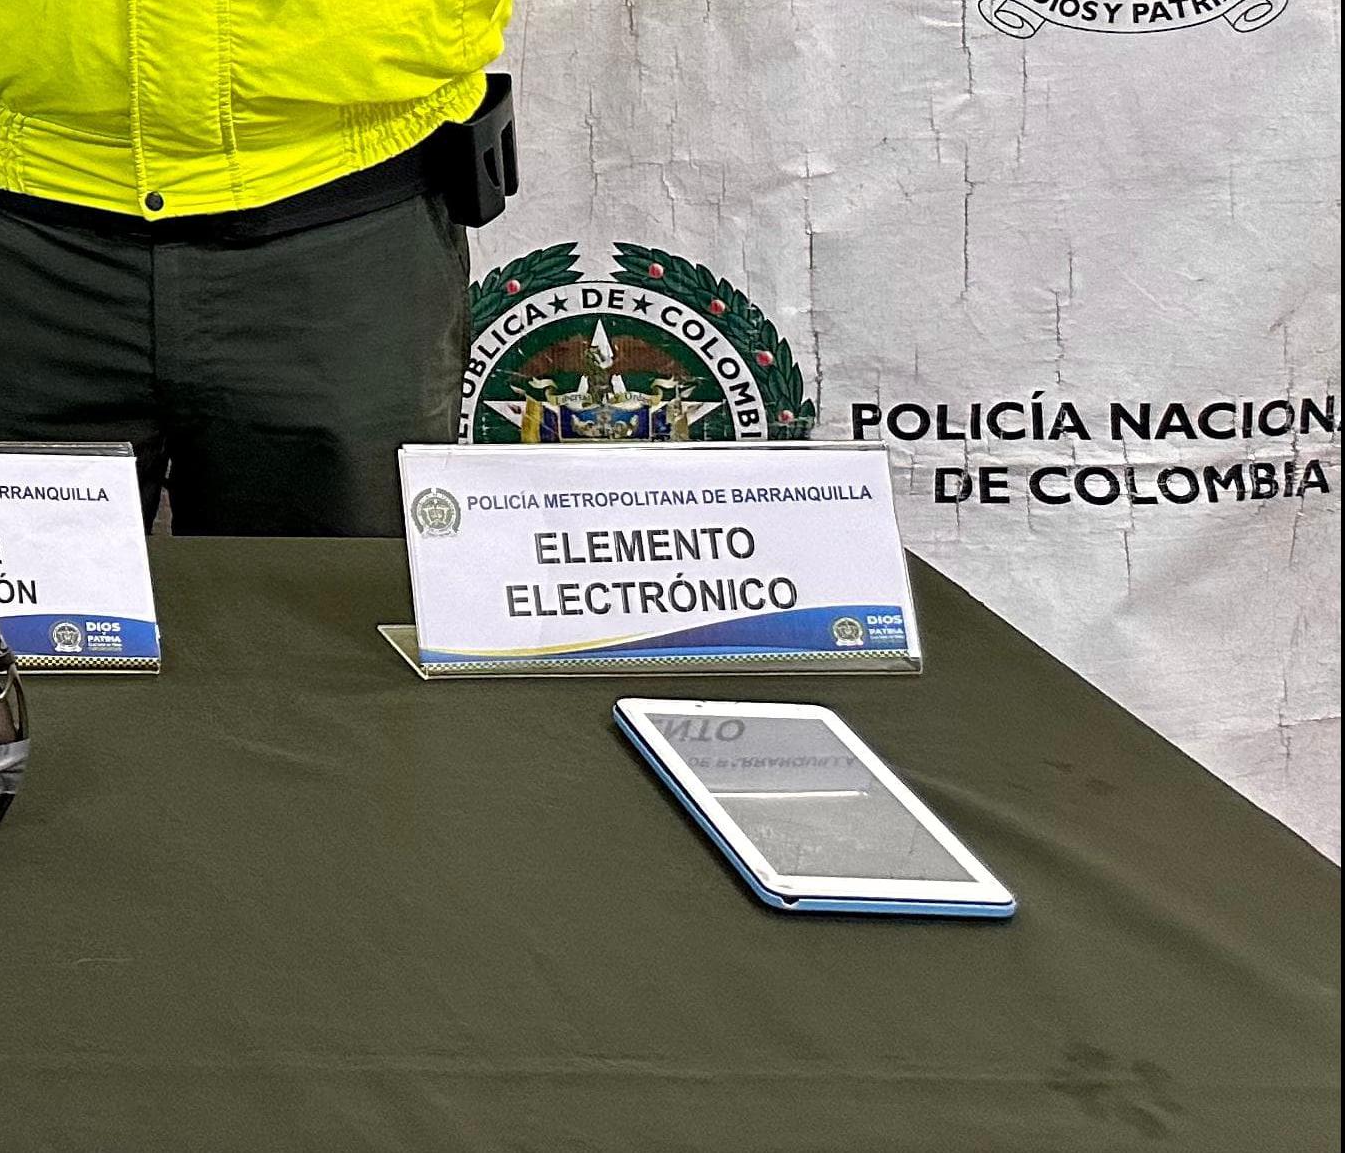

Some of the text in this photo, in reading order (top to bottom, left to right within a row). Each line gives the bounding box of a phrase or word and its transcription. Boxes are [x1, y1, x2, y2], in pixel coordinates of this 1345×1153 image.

[1107, 2, 1125, 24] Y
[581, 288, 625, 310] DE
[661, 305, 762, 439] COLOMBI
[851, 390, 1339, 441] POLICÍA NACION
[467, 484, 872, 511] POLICÍA METROPOLITANA DE BARRANQUILLA
[934, 458, 1330, 506] DE COLOMBIA
[534, 525, 756, 565] ELEMENTO
[506, 574, 798, 617] ELECTRÓNICO
[86, 622, 121, 632] DIOS
[867, 615, 903, 625] DIOS
